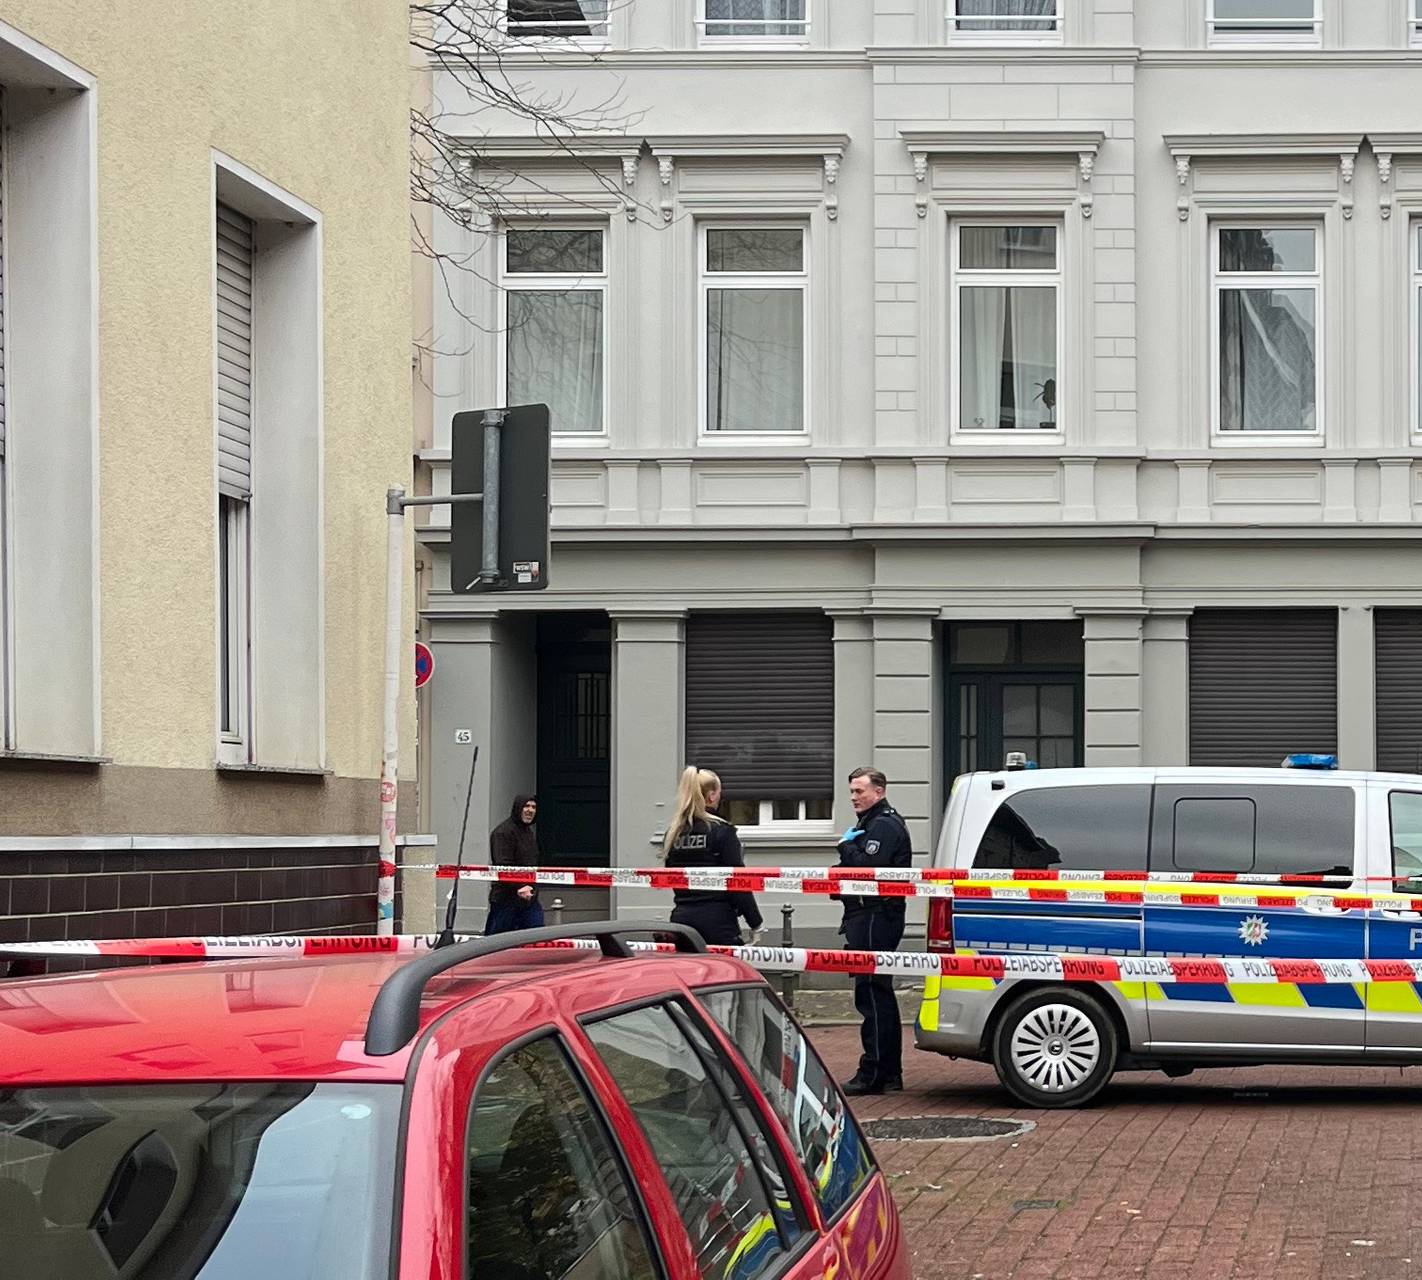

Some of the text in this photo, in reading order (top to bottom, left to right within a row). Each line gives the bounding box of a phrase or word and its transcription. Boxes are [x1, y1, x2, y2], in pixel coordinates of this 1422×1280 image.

[458, 732, 470, 741] 45
[673, 834, 707, 849] OLIZEI
[852, 883, 937, 894] POLIZEIABSPERRUNG
[810, 952, 958, 970] POLIZEIABSPERRUNG
[974, 956, 1104, 974] POLIZEIABSPERRUNG
[1118, 960, 1234, 977] POLIZEIABSPERRUNG
[1244, 962, 1351, 977] POLIZEIABSPERRUNG
